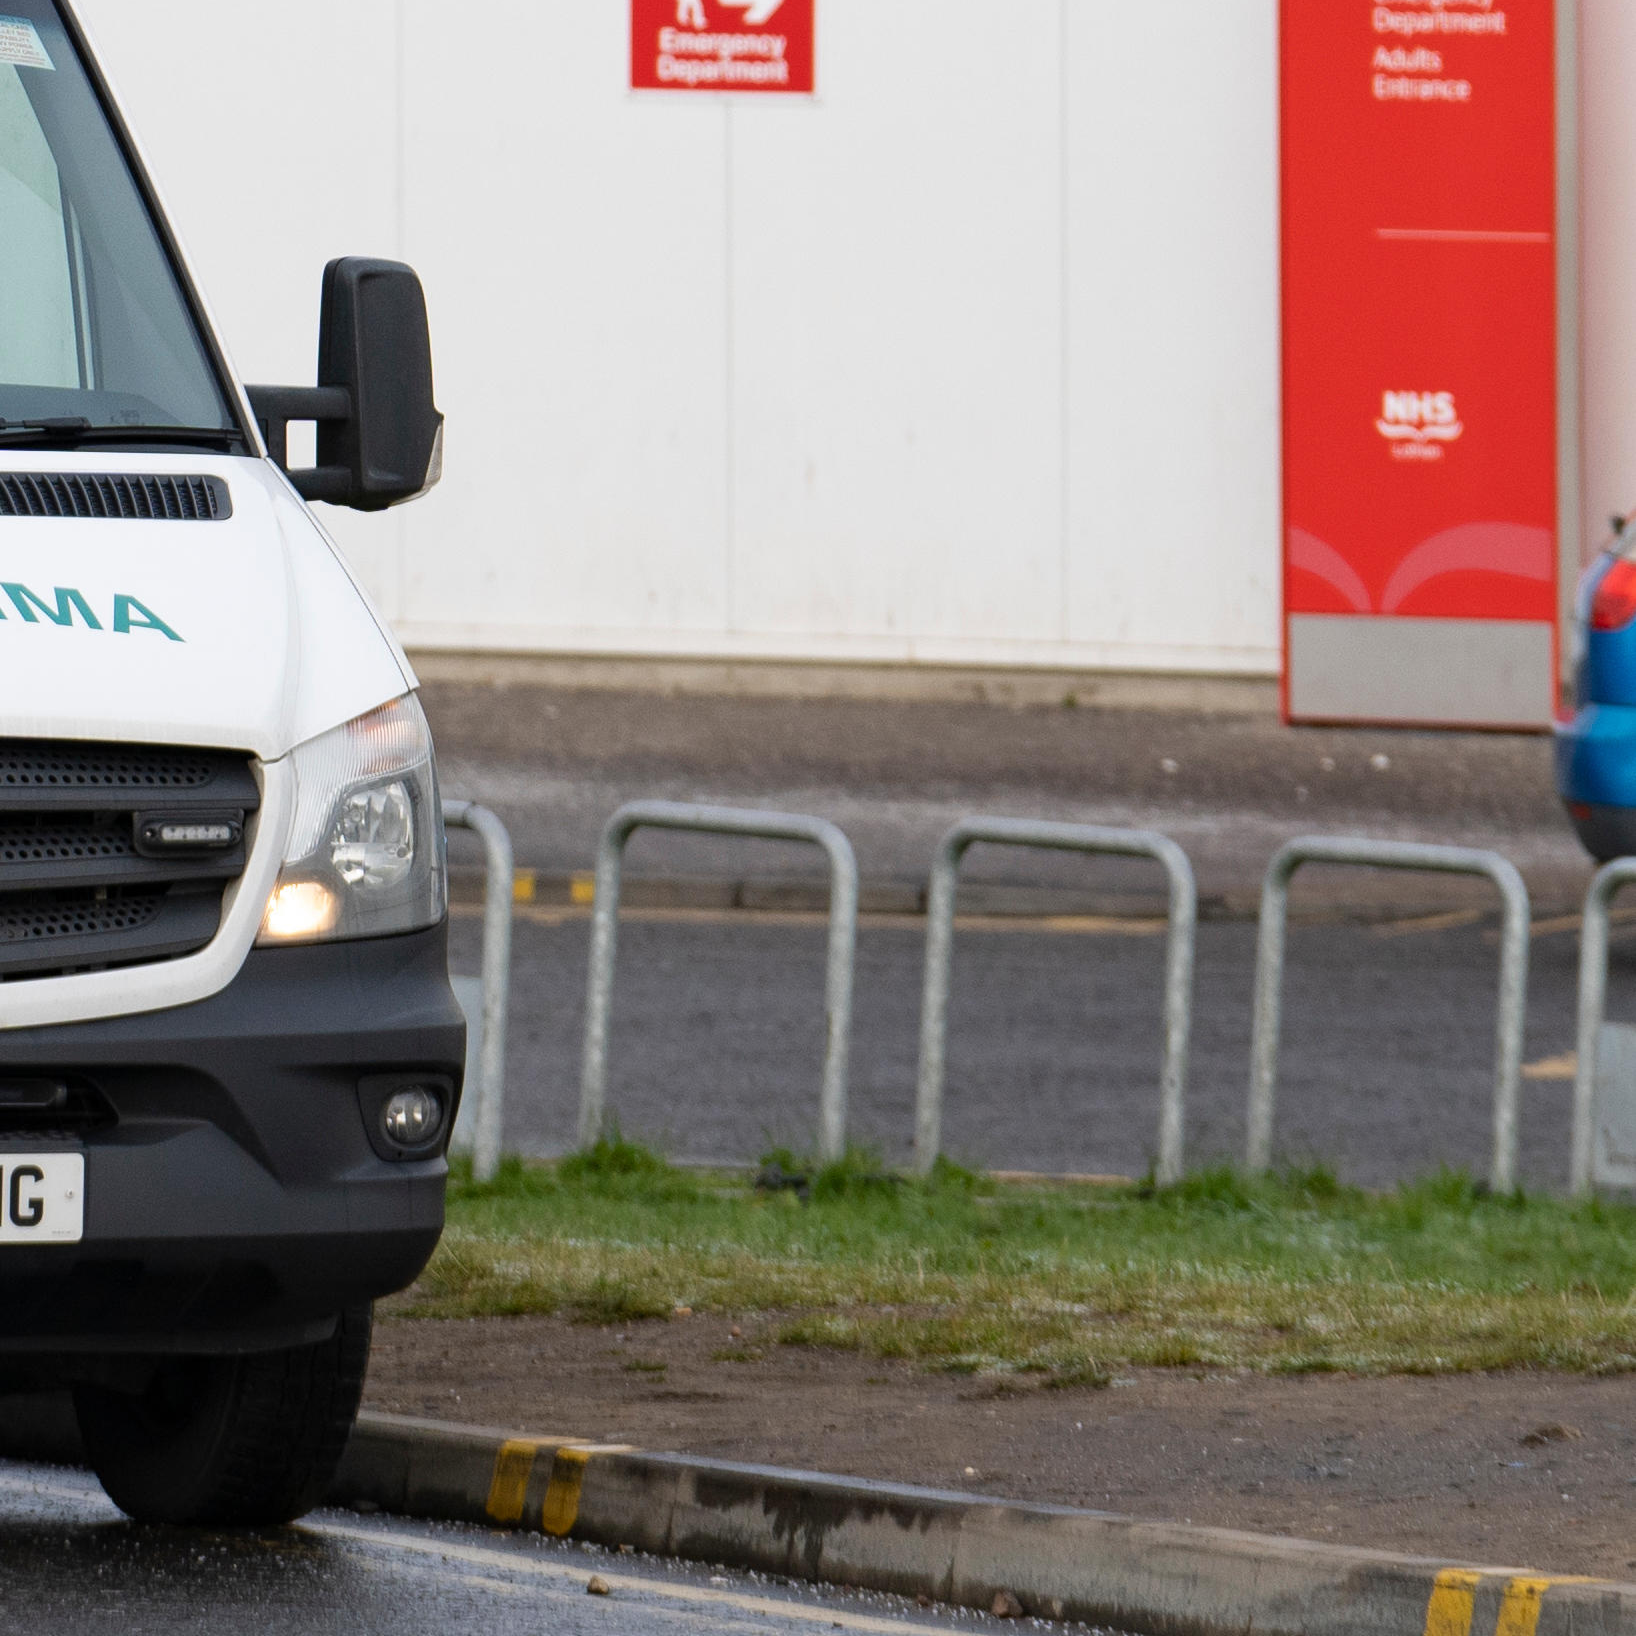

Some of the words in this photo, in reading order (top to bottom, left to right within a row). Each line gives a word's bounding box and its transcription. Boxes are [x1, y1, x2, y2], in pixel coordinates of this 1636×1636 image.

[1372, 6, 1506, 36] Department
[658, 26, 787, 61] Emergency
[657, 53, 789, 86] Department
[1372, 72, 1472, 101] Entrance
[1383, 390, 1457, 424] NHS
